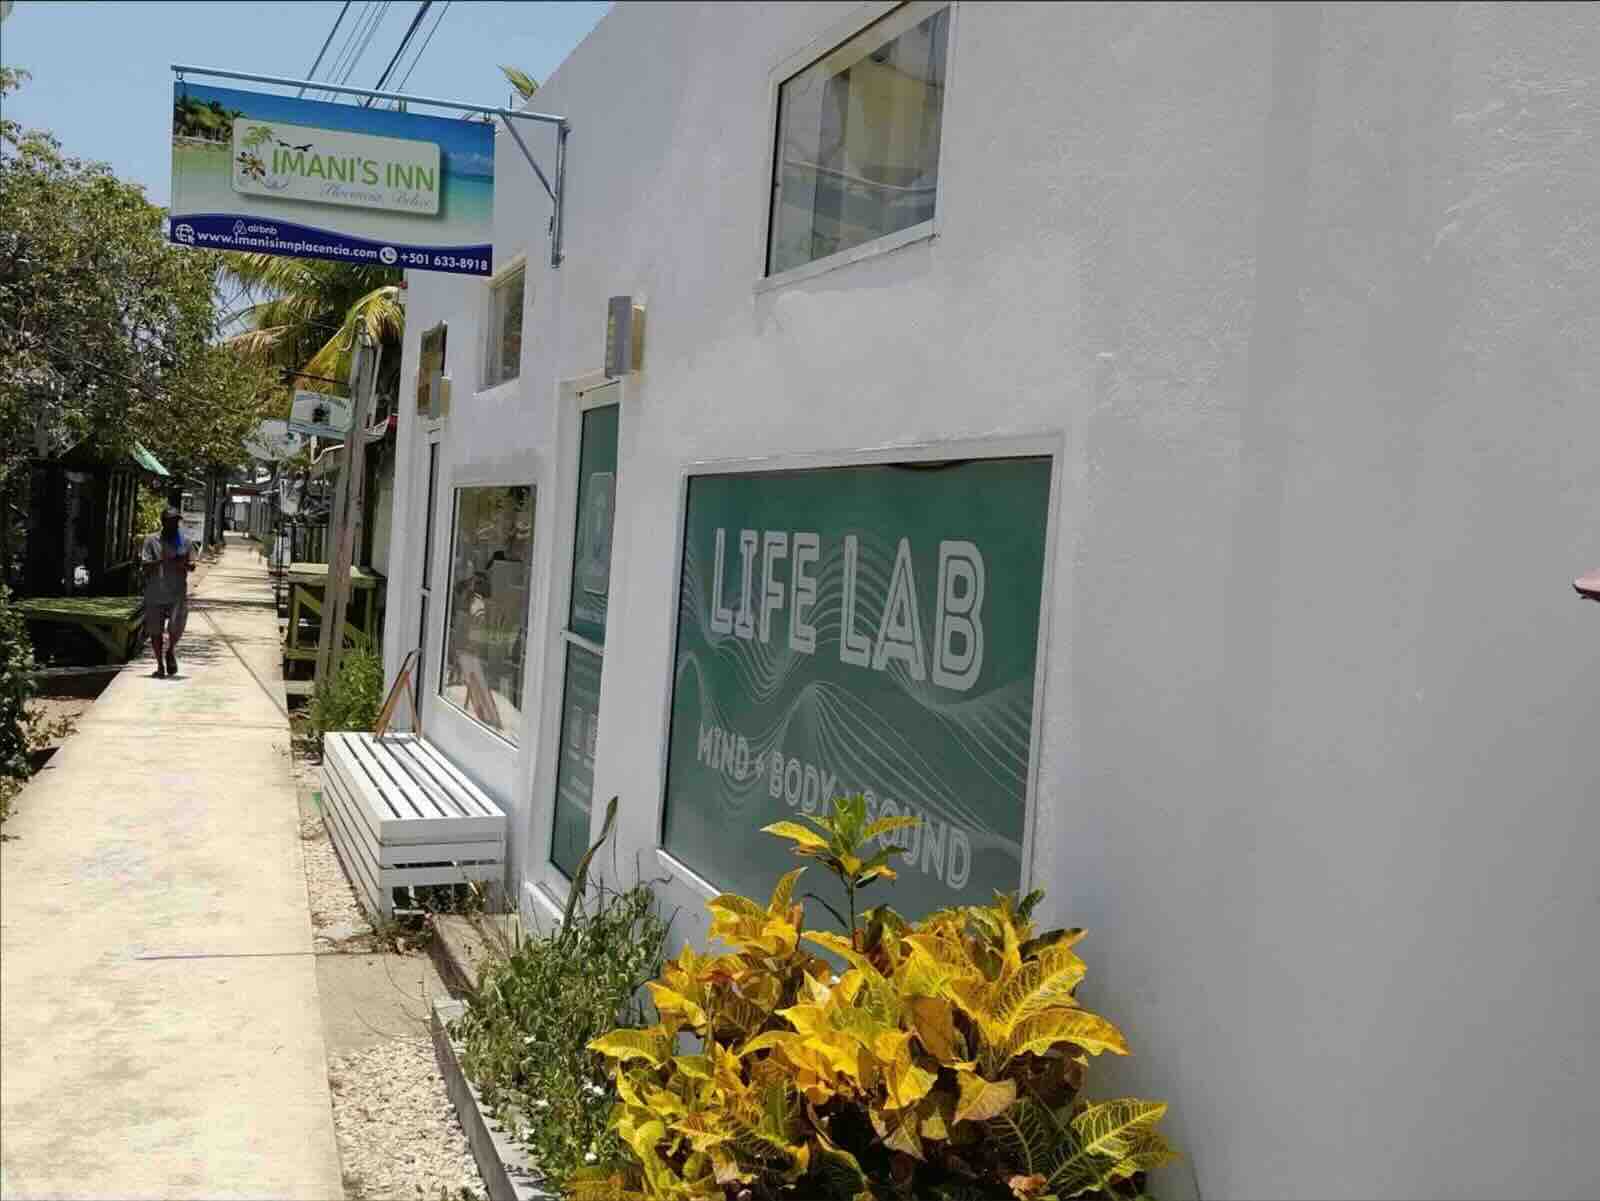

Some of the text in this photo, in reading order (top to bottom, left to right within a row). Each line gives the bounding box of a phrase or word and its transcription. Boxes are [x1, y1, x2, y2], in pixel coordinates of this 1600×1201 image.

[272, 149, 434, 193] IMANI'S INN
[197, 231, 377, 259] www.imanisinnplacencia.com
[400, 253, 488, 271] +501 633-8918
[710, 527, 985, 691] LIFE LAB
[697, 726, 750, 781] MIND
[768, 750, 837, 818] BODY
